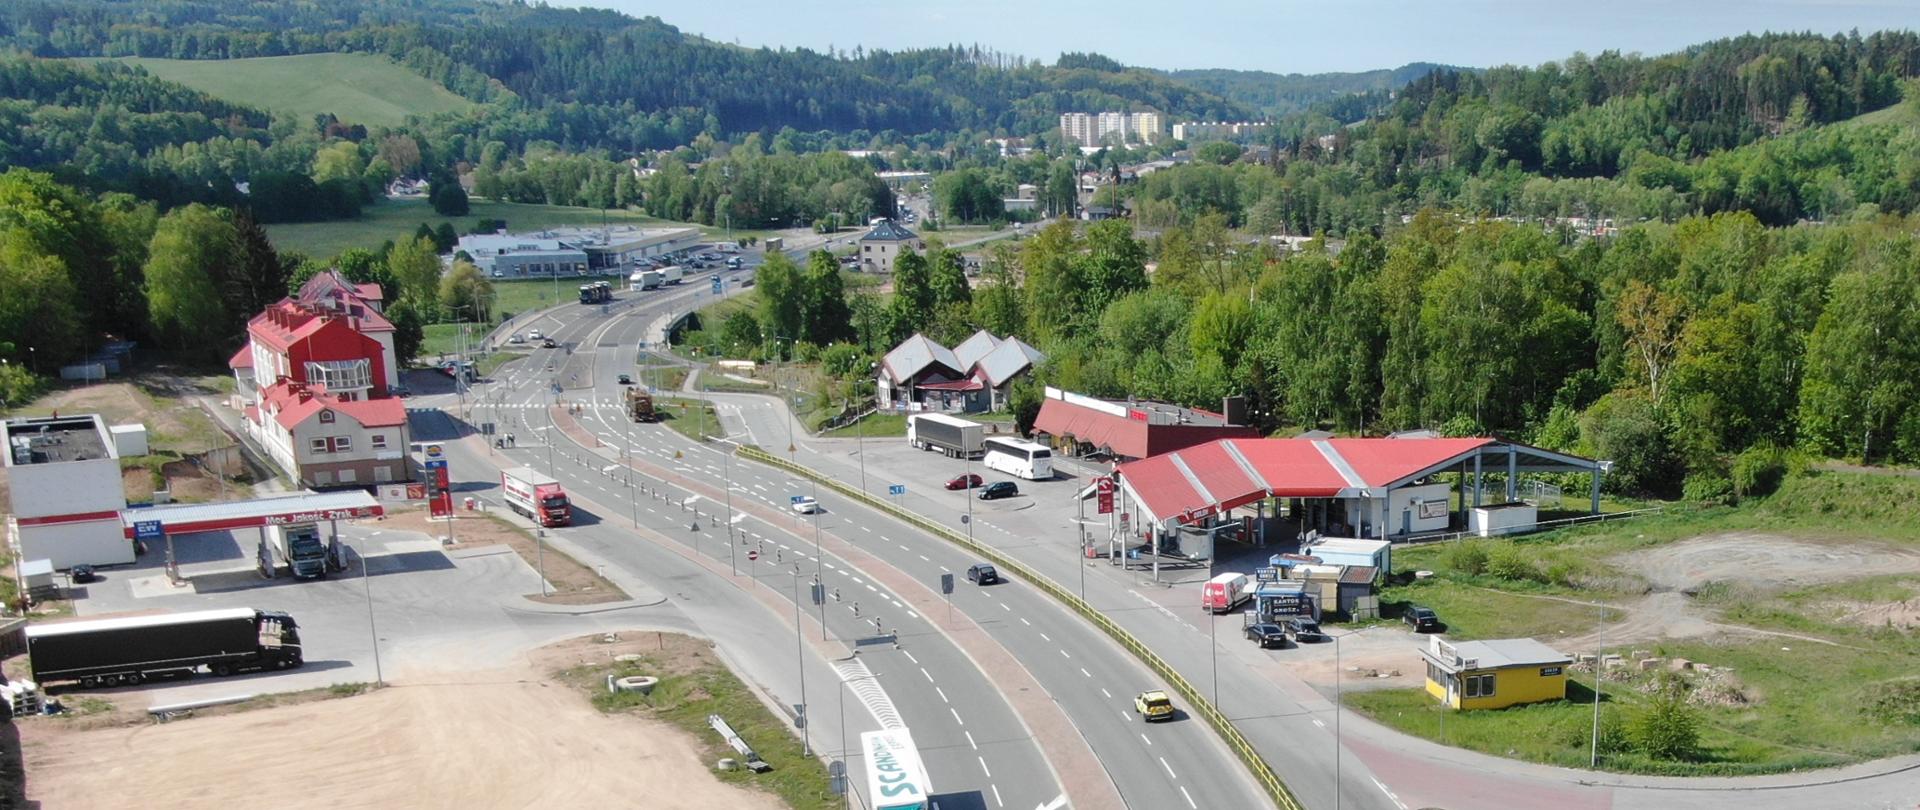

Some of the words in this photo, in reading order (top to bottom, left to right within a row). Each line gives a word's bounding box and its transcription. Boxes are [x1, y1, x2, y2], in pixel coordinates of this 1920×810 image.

[265, 516, 287, 525] Moc
[293, 511, 325, 522] Jakość
[328, 509, 352, 519] Zysk
